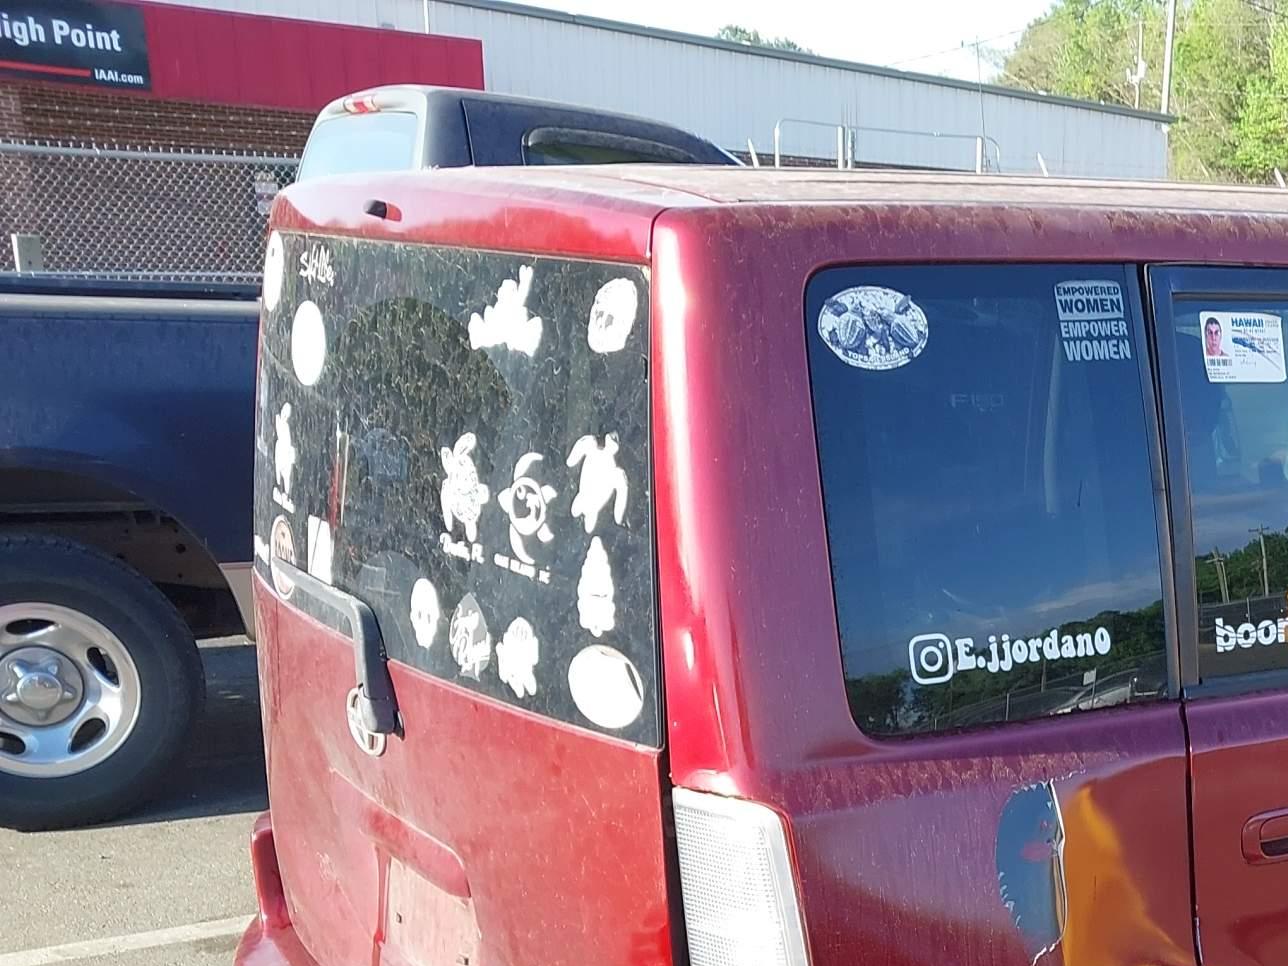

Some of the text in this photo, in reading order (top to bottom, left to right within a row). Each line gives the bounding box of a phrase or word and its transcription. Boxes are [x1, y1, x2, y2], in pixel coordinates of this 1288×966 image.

[0, 12, 122, 52] igh Point
[94, 68, 144, 84] IAAI.com
[1056, 286, 1120, 296] EMPOWERED
[1058, 298, 1122, 313] WOMEN
[1060, 320, 1128, 338] EMPOWER
[1231, 317, 1264, 328] HAWAII
[1063, 339, 1131, 361] WOMEN
